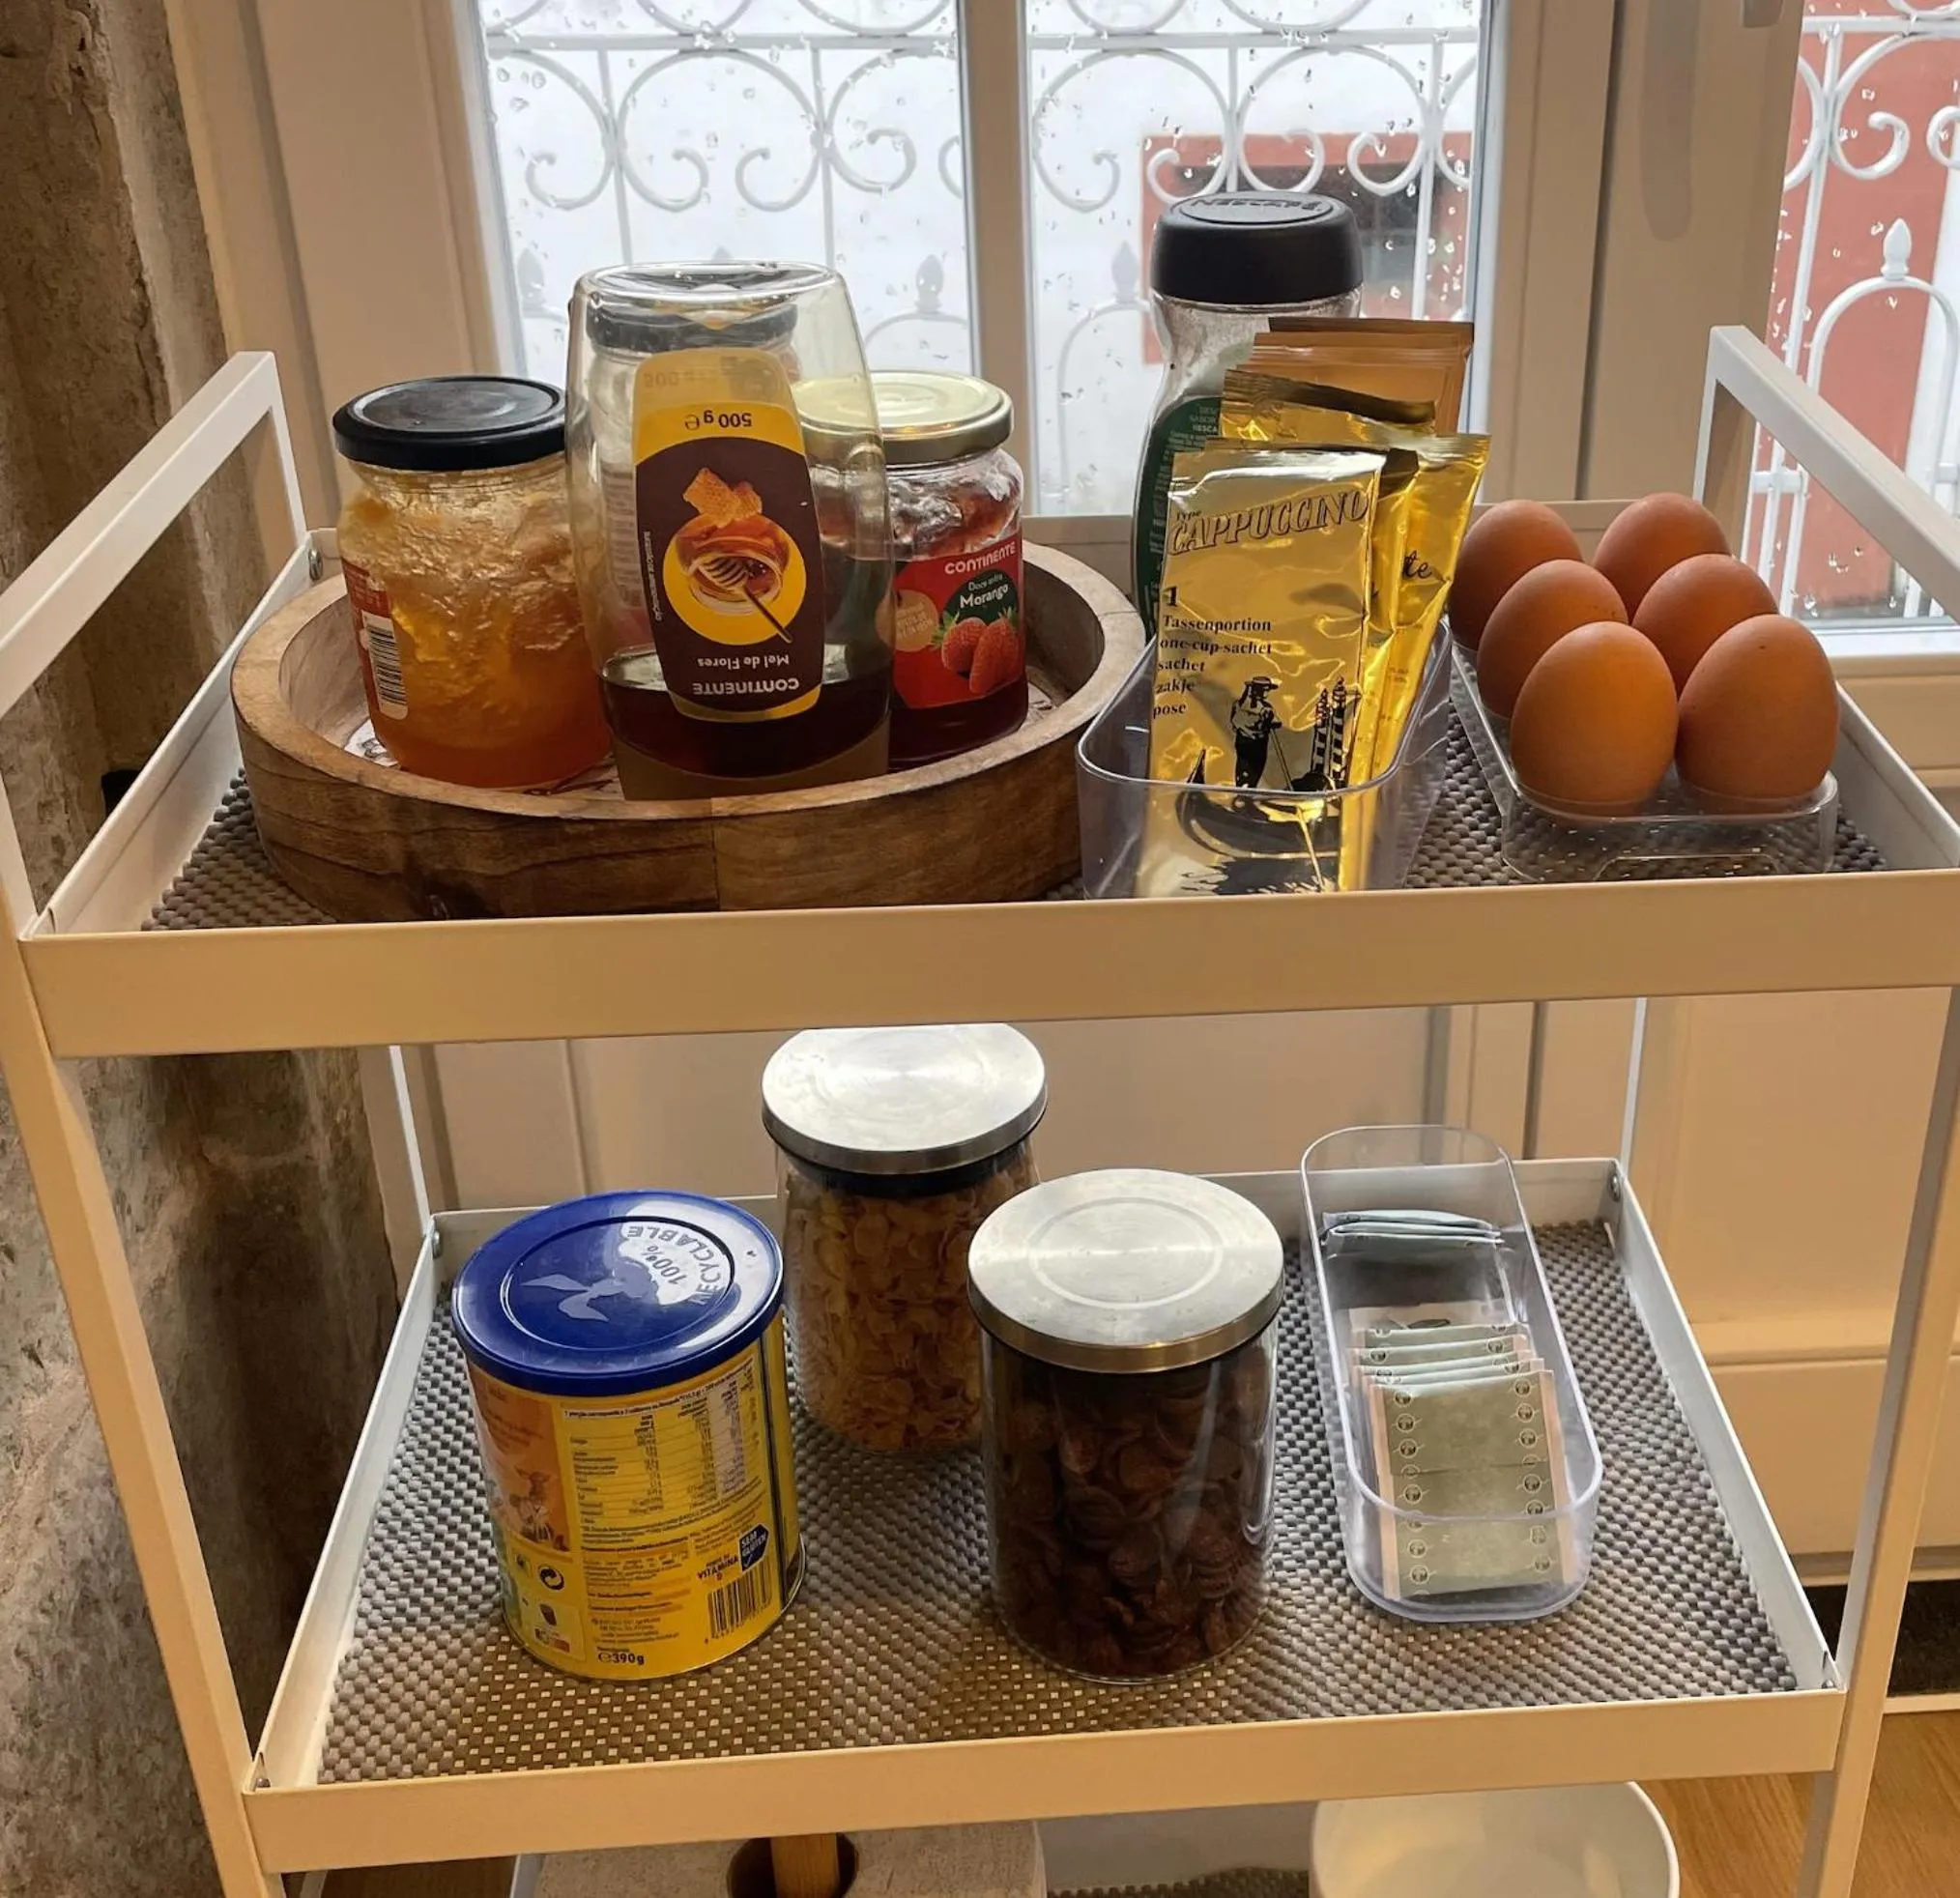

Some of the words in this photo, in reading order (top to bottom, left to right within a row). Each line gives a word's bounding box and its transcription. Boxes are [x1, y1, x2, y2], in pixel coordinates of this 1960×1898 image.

[703, 409, 714, 423] g
[718, 412, 752, 428] 500
[1167, 490, 1369, 556] CAPPUCCINO
[944, 541, 1016, 575] CONTINENTE
[960, 584, 1009, 609] Morango
[1161, 586, 1178, 608] 1
[1163, 615, 1272, 634] Tassenportion
[1160, 639, 1272, 655] one-cup-sachet
[697, 657, 740, 670] Flores
[743, 656, 761, 669] de
[763, 654, 790, 668] Mel
[1158, 658, 1205, 673] sachet
[692, 677, 800, 695] CONTINENTE
[1156, 678, 1196, 694] zakje
[1153, 703, 1187, 719] pose
[626, 1225, 725, 1305] RECYCLABLE
[641, 1245, 687, 1284] 100%
[697, 1556, 738, 1579] VITAMINA
